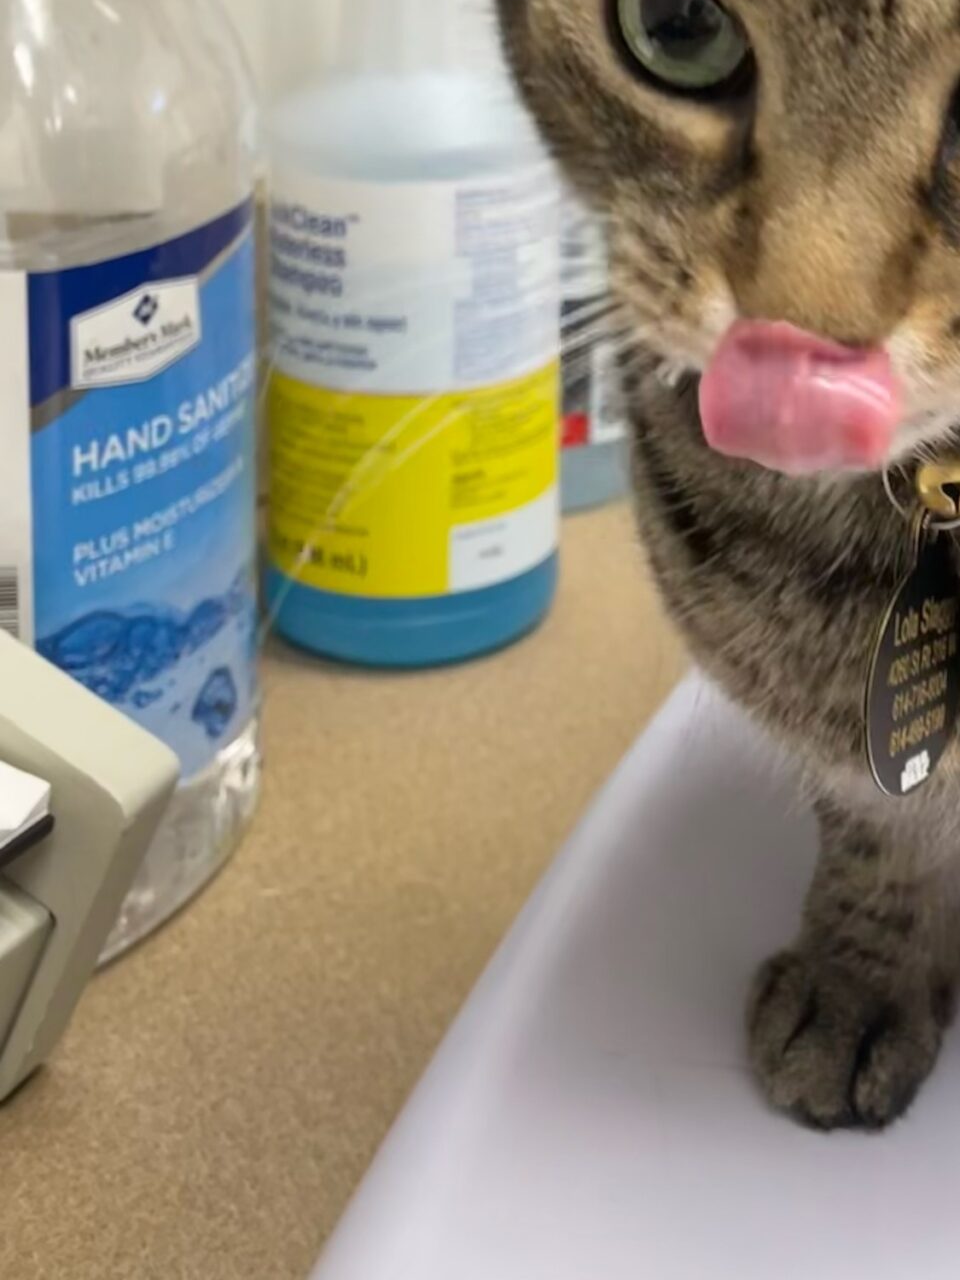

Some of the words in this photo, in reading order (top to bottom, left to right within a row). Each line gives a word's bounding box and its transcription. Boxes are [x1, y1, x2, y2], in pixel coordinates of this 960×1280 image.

[73, 415, 172, 478] HAND
[72, 470, 129, 505] KILLS
[73, 526, 129, 564] PLUS
[74, 538, 160, 586] VITAMIN
[163, 528, 176, 551] E
